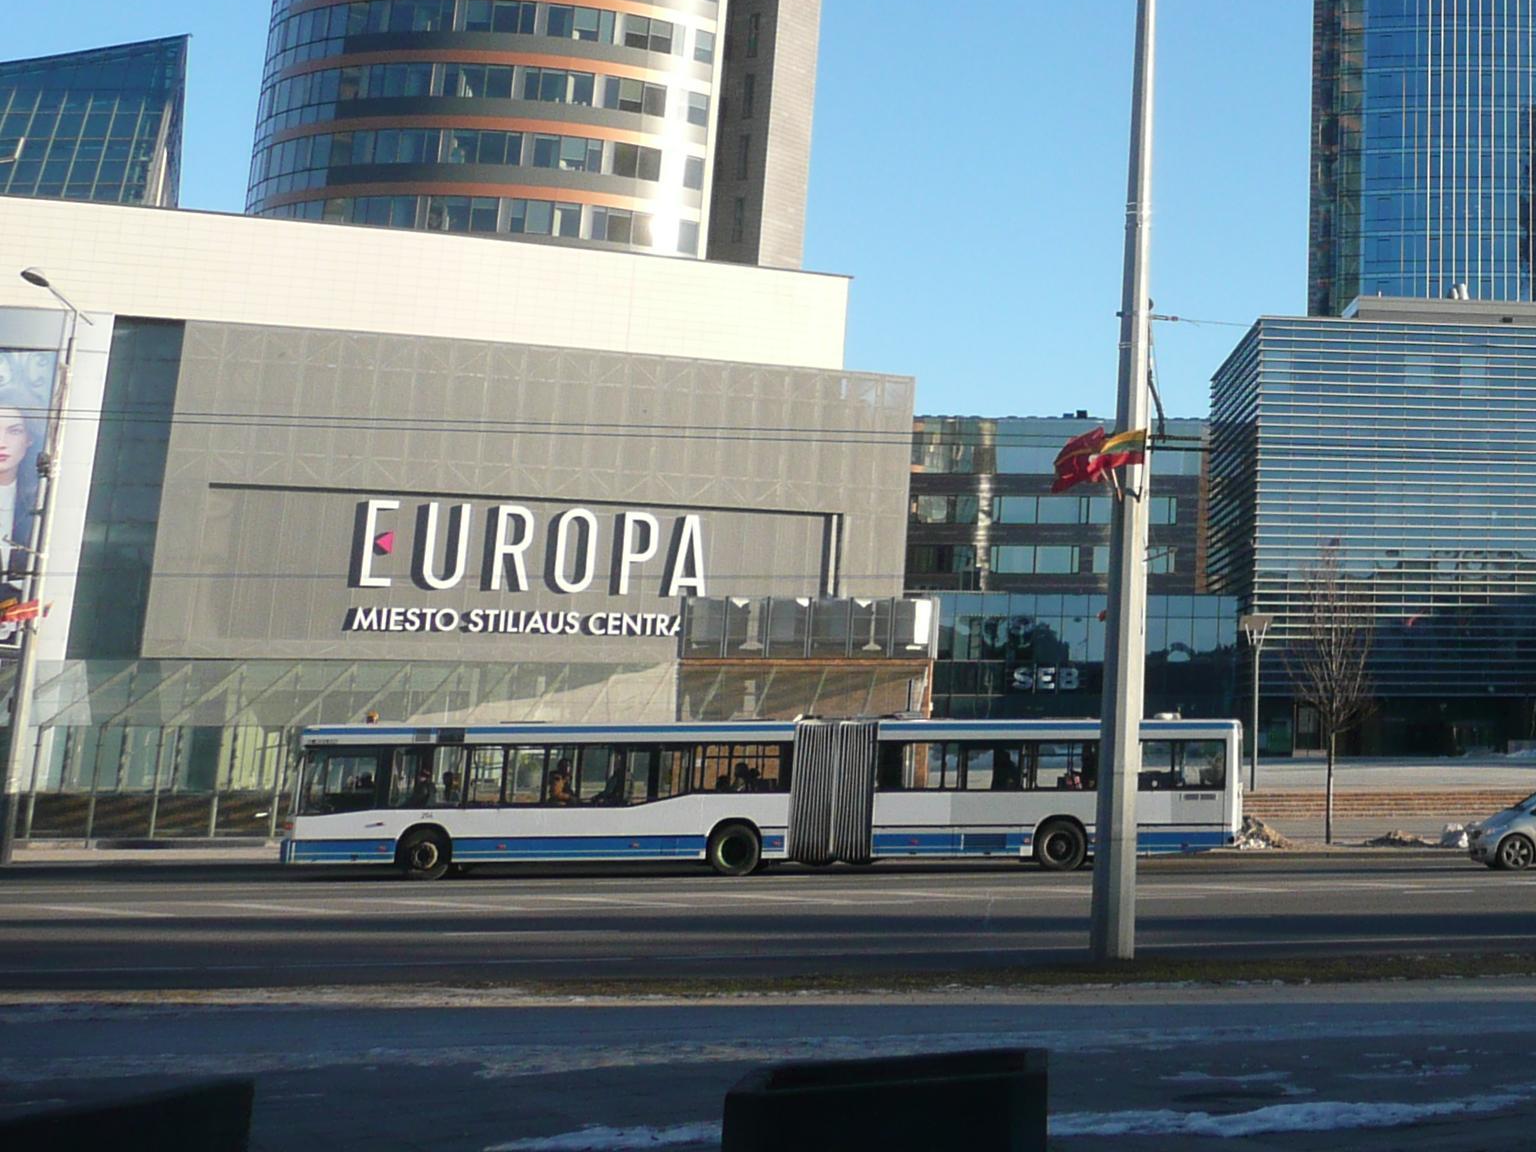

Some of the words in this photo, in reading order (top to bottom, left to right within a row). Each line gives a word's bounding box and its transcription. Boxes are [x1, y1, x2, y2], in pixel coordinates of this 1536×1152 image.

[357, 499, 706, 597] EUROPA
[351, 606, 459, 632] MIESTO
[467, 608, 580, 634] STILIAUS
[1012, 667, 1079, 689] SEB
